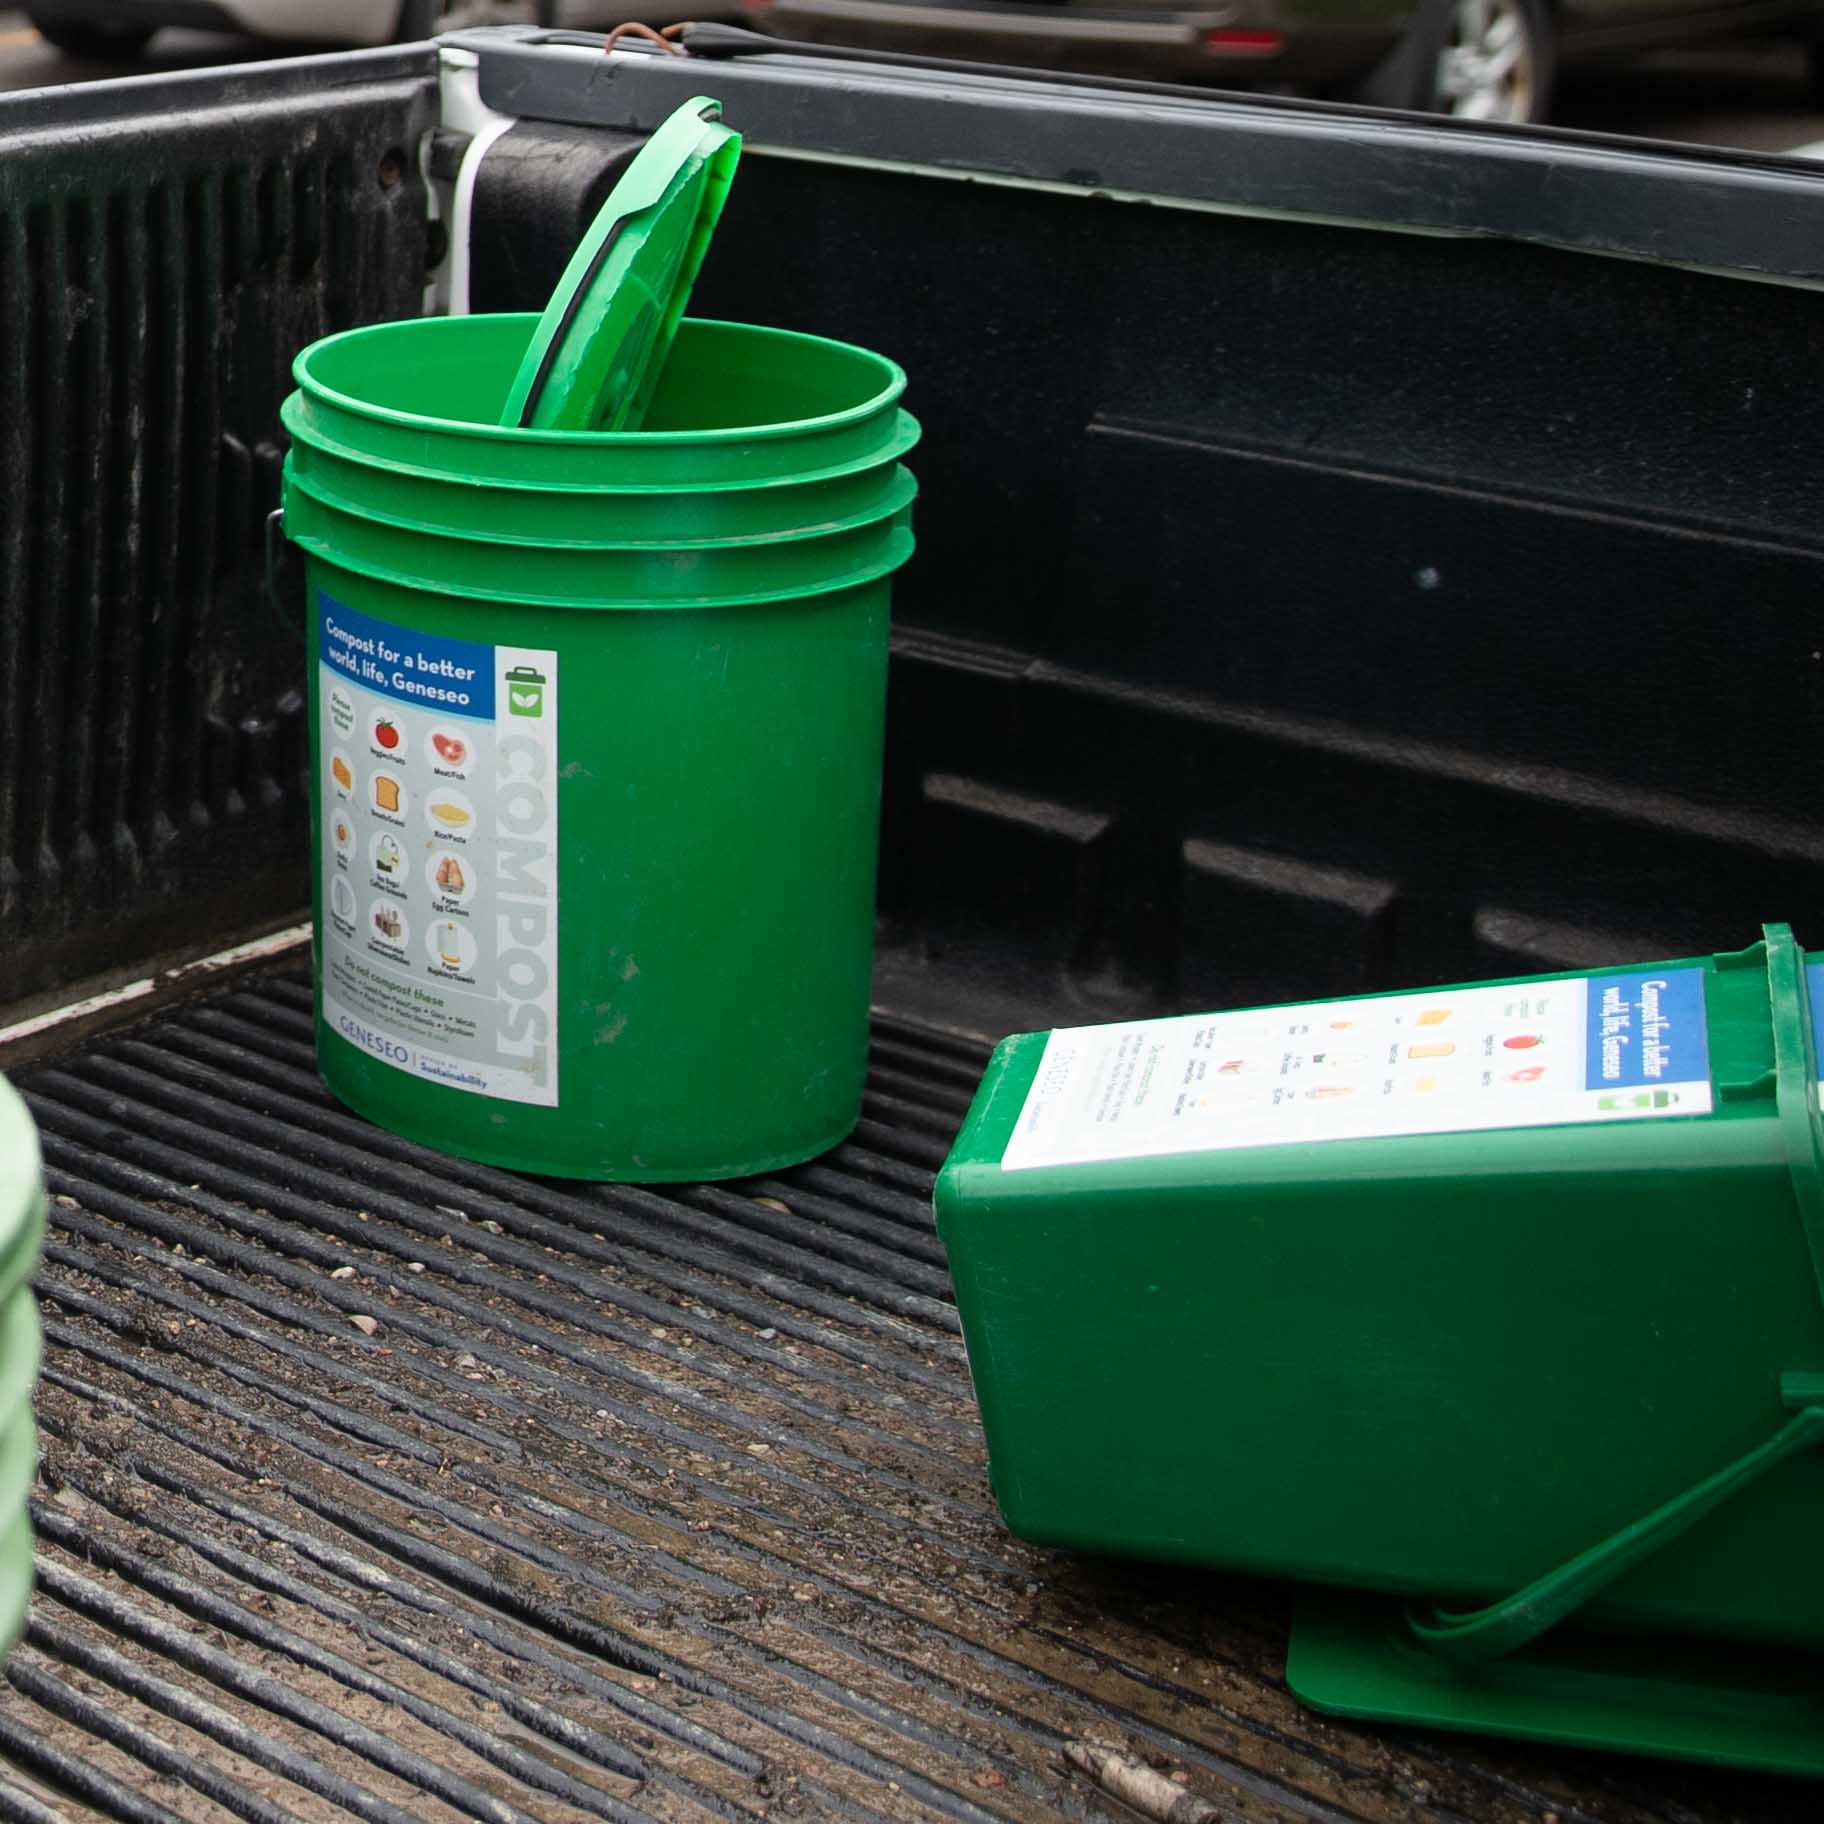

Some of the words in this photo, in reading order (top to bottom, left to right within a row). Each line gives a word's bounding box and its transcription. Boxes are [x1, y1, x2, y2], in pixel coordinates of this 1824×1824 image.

[326, 617, 375, 656] Compost
[377, 641, 400, 663] for
[403, 655, 413, 668] a
[418, 653, 476, 681] better
[328, 646, 360, 675] world,
[362, 659, 389, 688] life,
[392, 672, 470, 706] Geneseo
[496, 734, 549, 1087] COMPOST
[371, 974, 412, 997] compost
[414, 987, 445, 1008] these
[340, 1015, 409, 1064] GENESEO
[421, 1061, 487, 1089] Sustainability
